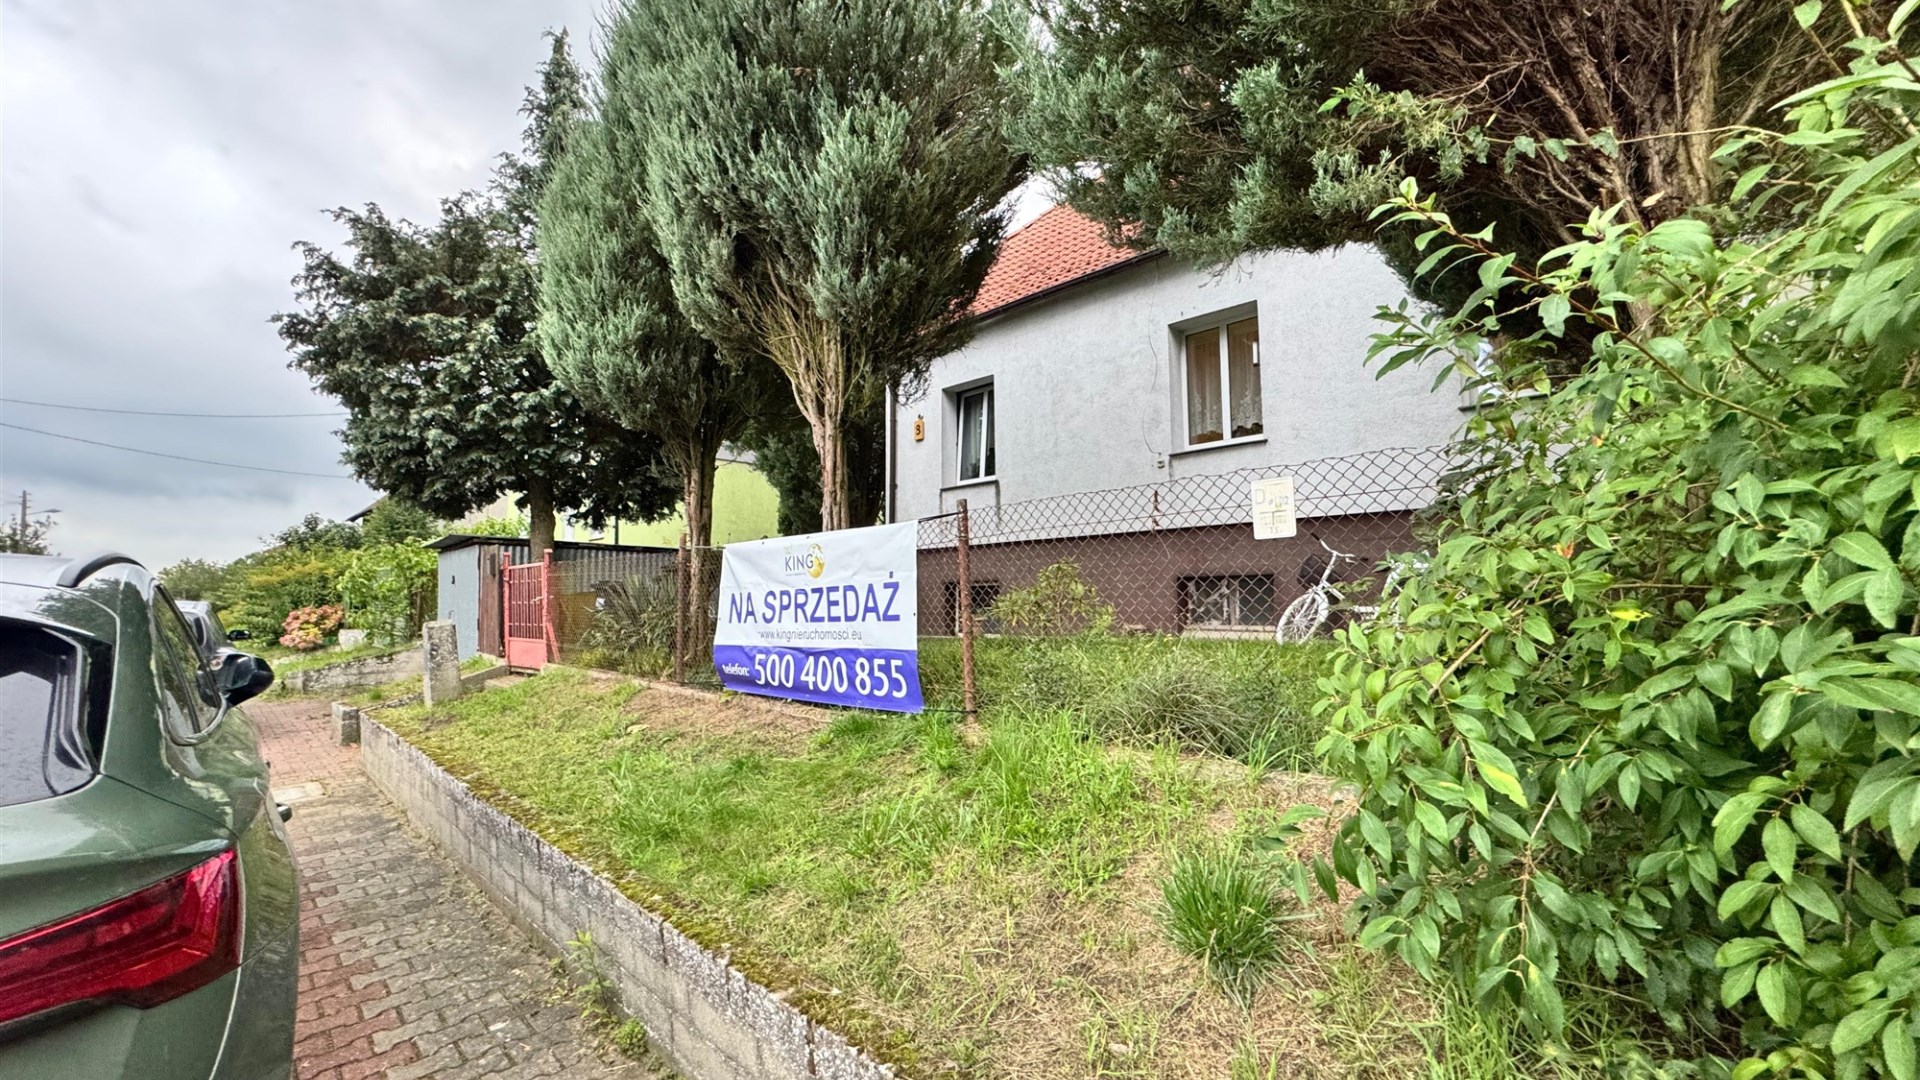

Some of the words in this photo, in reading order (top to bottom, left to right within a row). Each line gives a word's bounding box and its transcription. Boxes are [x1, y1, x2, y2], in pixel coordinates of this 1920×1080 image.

[784, 553, 814, 572] KING
[728, 592, 757, 624] NA
[762, 571, 900, 624] SPRZEDAŻ
[753, 653, 795, 689] 500
[800, 655, 848, 694] 400
[855, 657, 908, 698] 855
